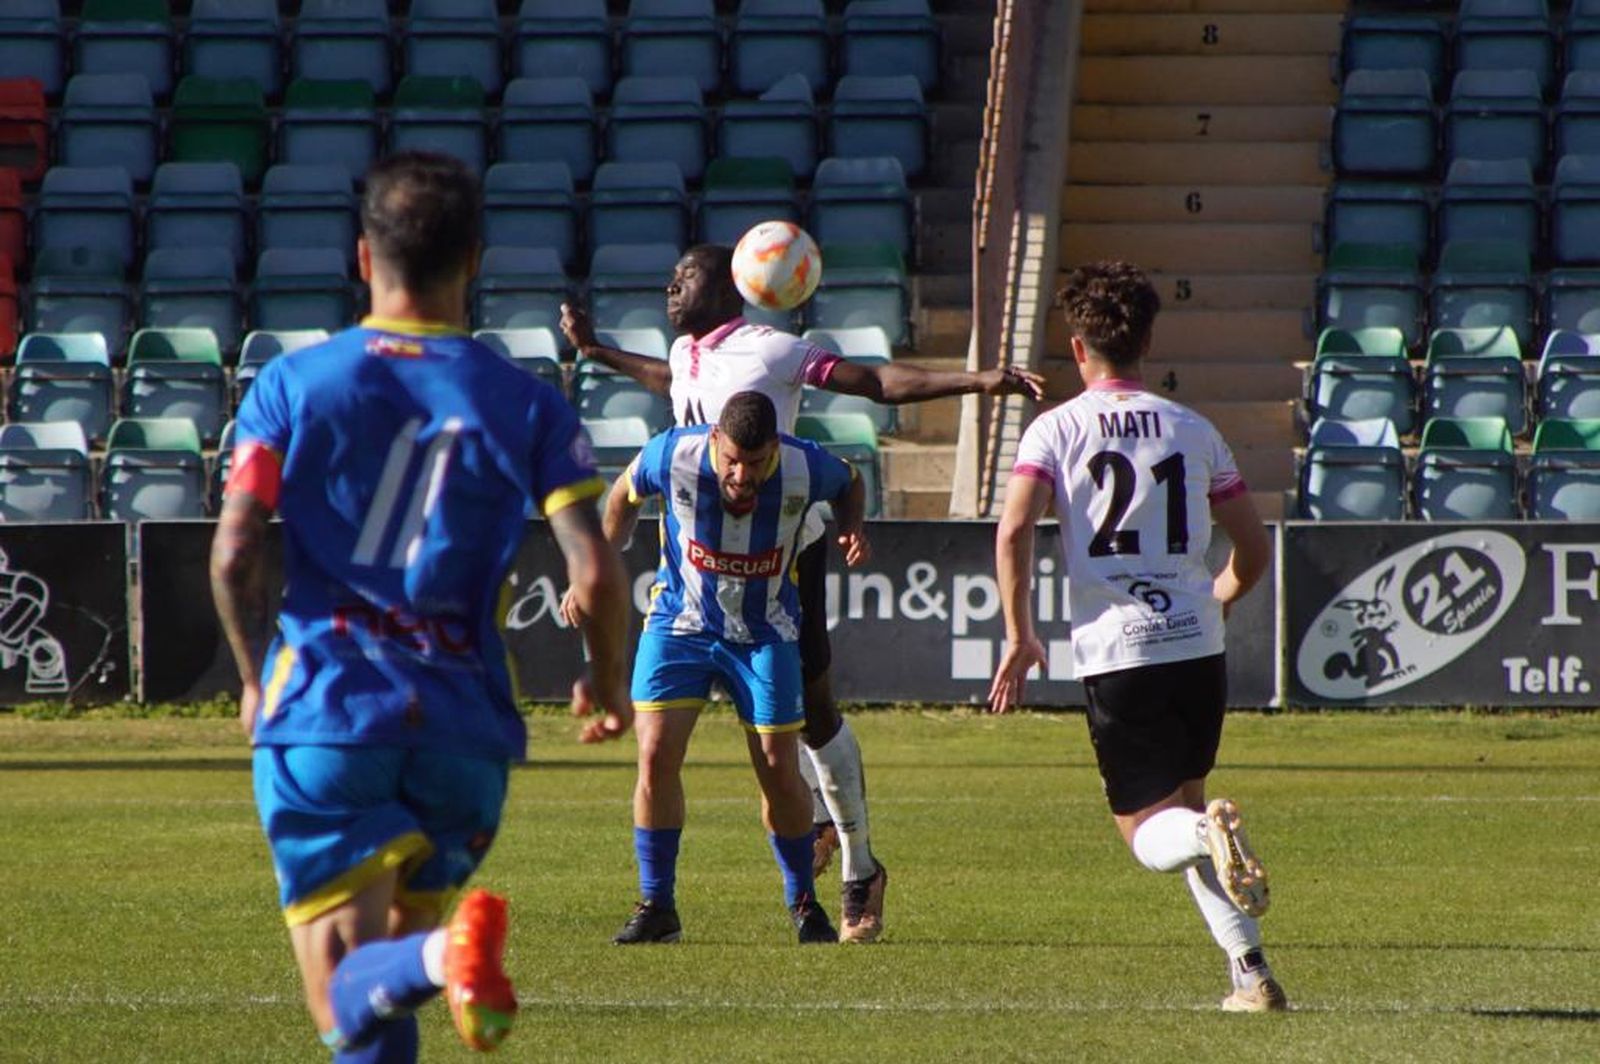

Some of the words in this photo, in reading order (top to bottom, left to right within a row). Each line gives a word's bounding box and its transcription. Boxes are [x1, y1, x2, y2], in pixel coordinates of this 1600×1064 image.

[1203, 24, 1219, 45] 8
[1195, 114, 1211, 136] 7
[1185, 192, 1203, 213] 6
[1162, 370, 1177, 392] 4
[1098, 410, 1162, 438] MATI
[350, 417, 463, 569] 11
[1087, 450, 1189, 558] 21
[690, 547, 778, 576] Pascual
[1410, 551, 1486, 626] 21
[1502, 655, 1591, 693] Telf.
